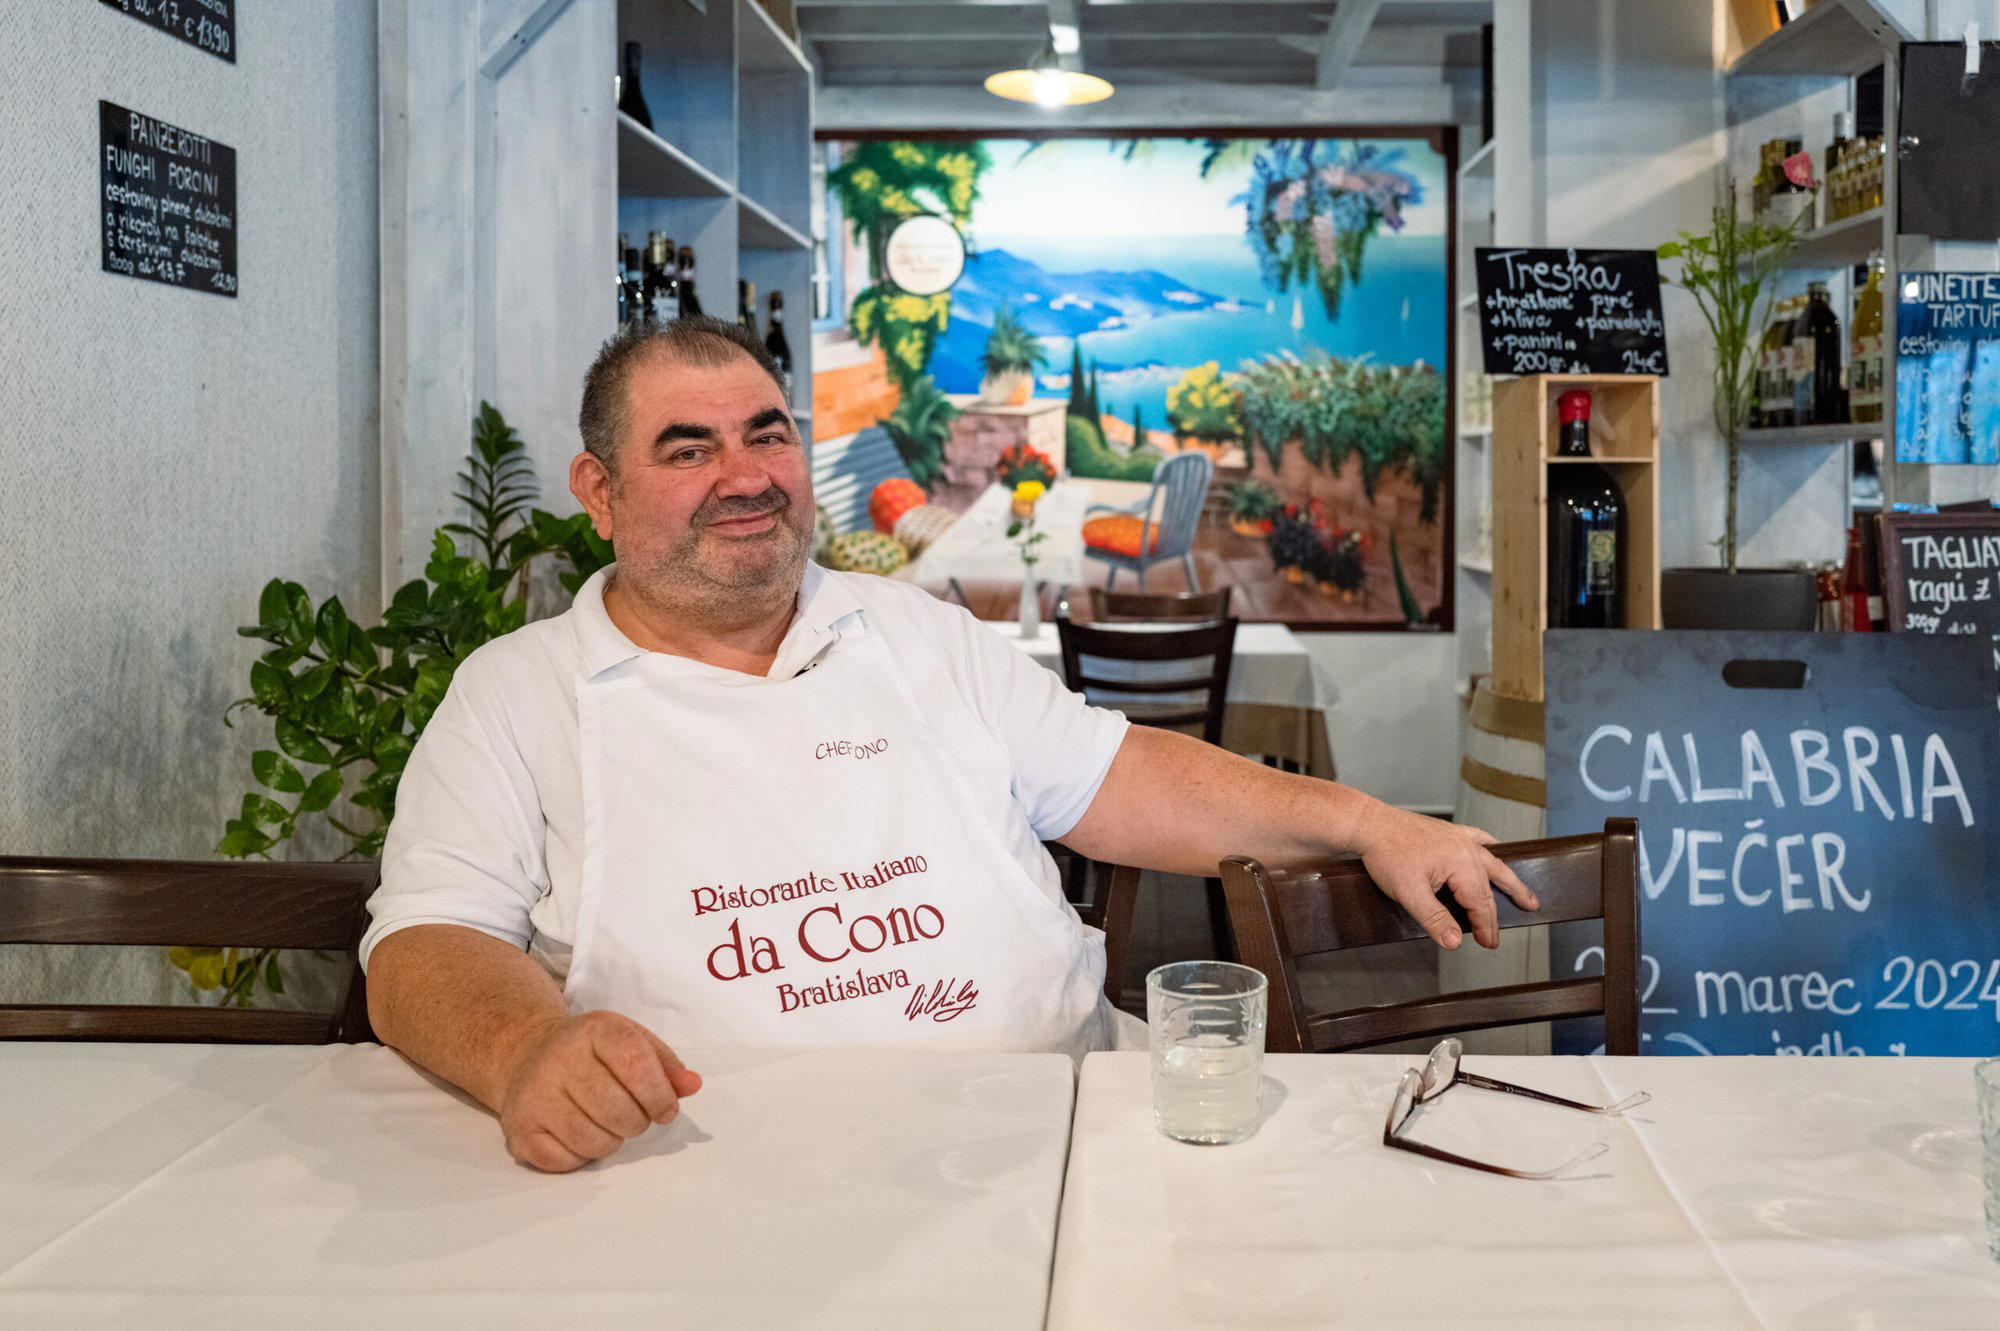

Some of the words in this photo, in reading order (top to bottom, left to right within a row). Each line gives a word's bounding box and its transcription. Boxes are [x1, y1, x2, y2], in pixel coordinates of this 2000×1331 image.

[130, 112, 211, 165] PANZEROTTI
[106, 143, 156, 182] FUNGHI
[168, 161, 219, 197] PORCINI
[106, 211, 116, 226] a
[1487, 248, 1622, 292] Treska
[1579, 724, 1975, 828] CALABRIA
[691, 871, 838, 916] Ristorante
[839, 855, 928, 892] Italiano
[1639, 818, 1872, 914] VEČER
[706, 917, 786, 981] da
[797, 902, 945, 963] Cono
[776, 967, 912, 1014] Bratislava
[1694, 969, 1863, 1019] marec
[1874, 955, 2000, 1023] 2024
